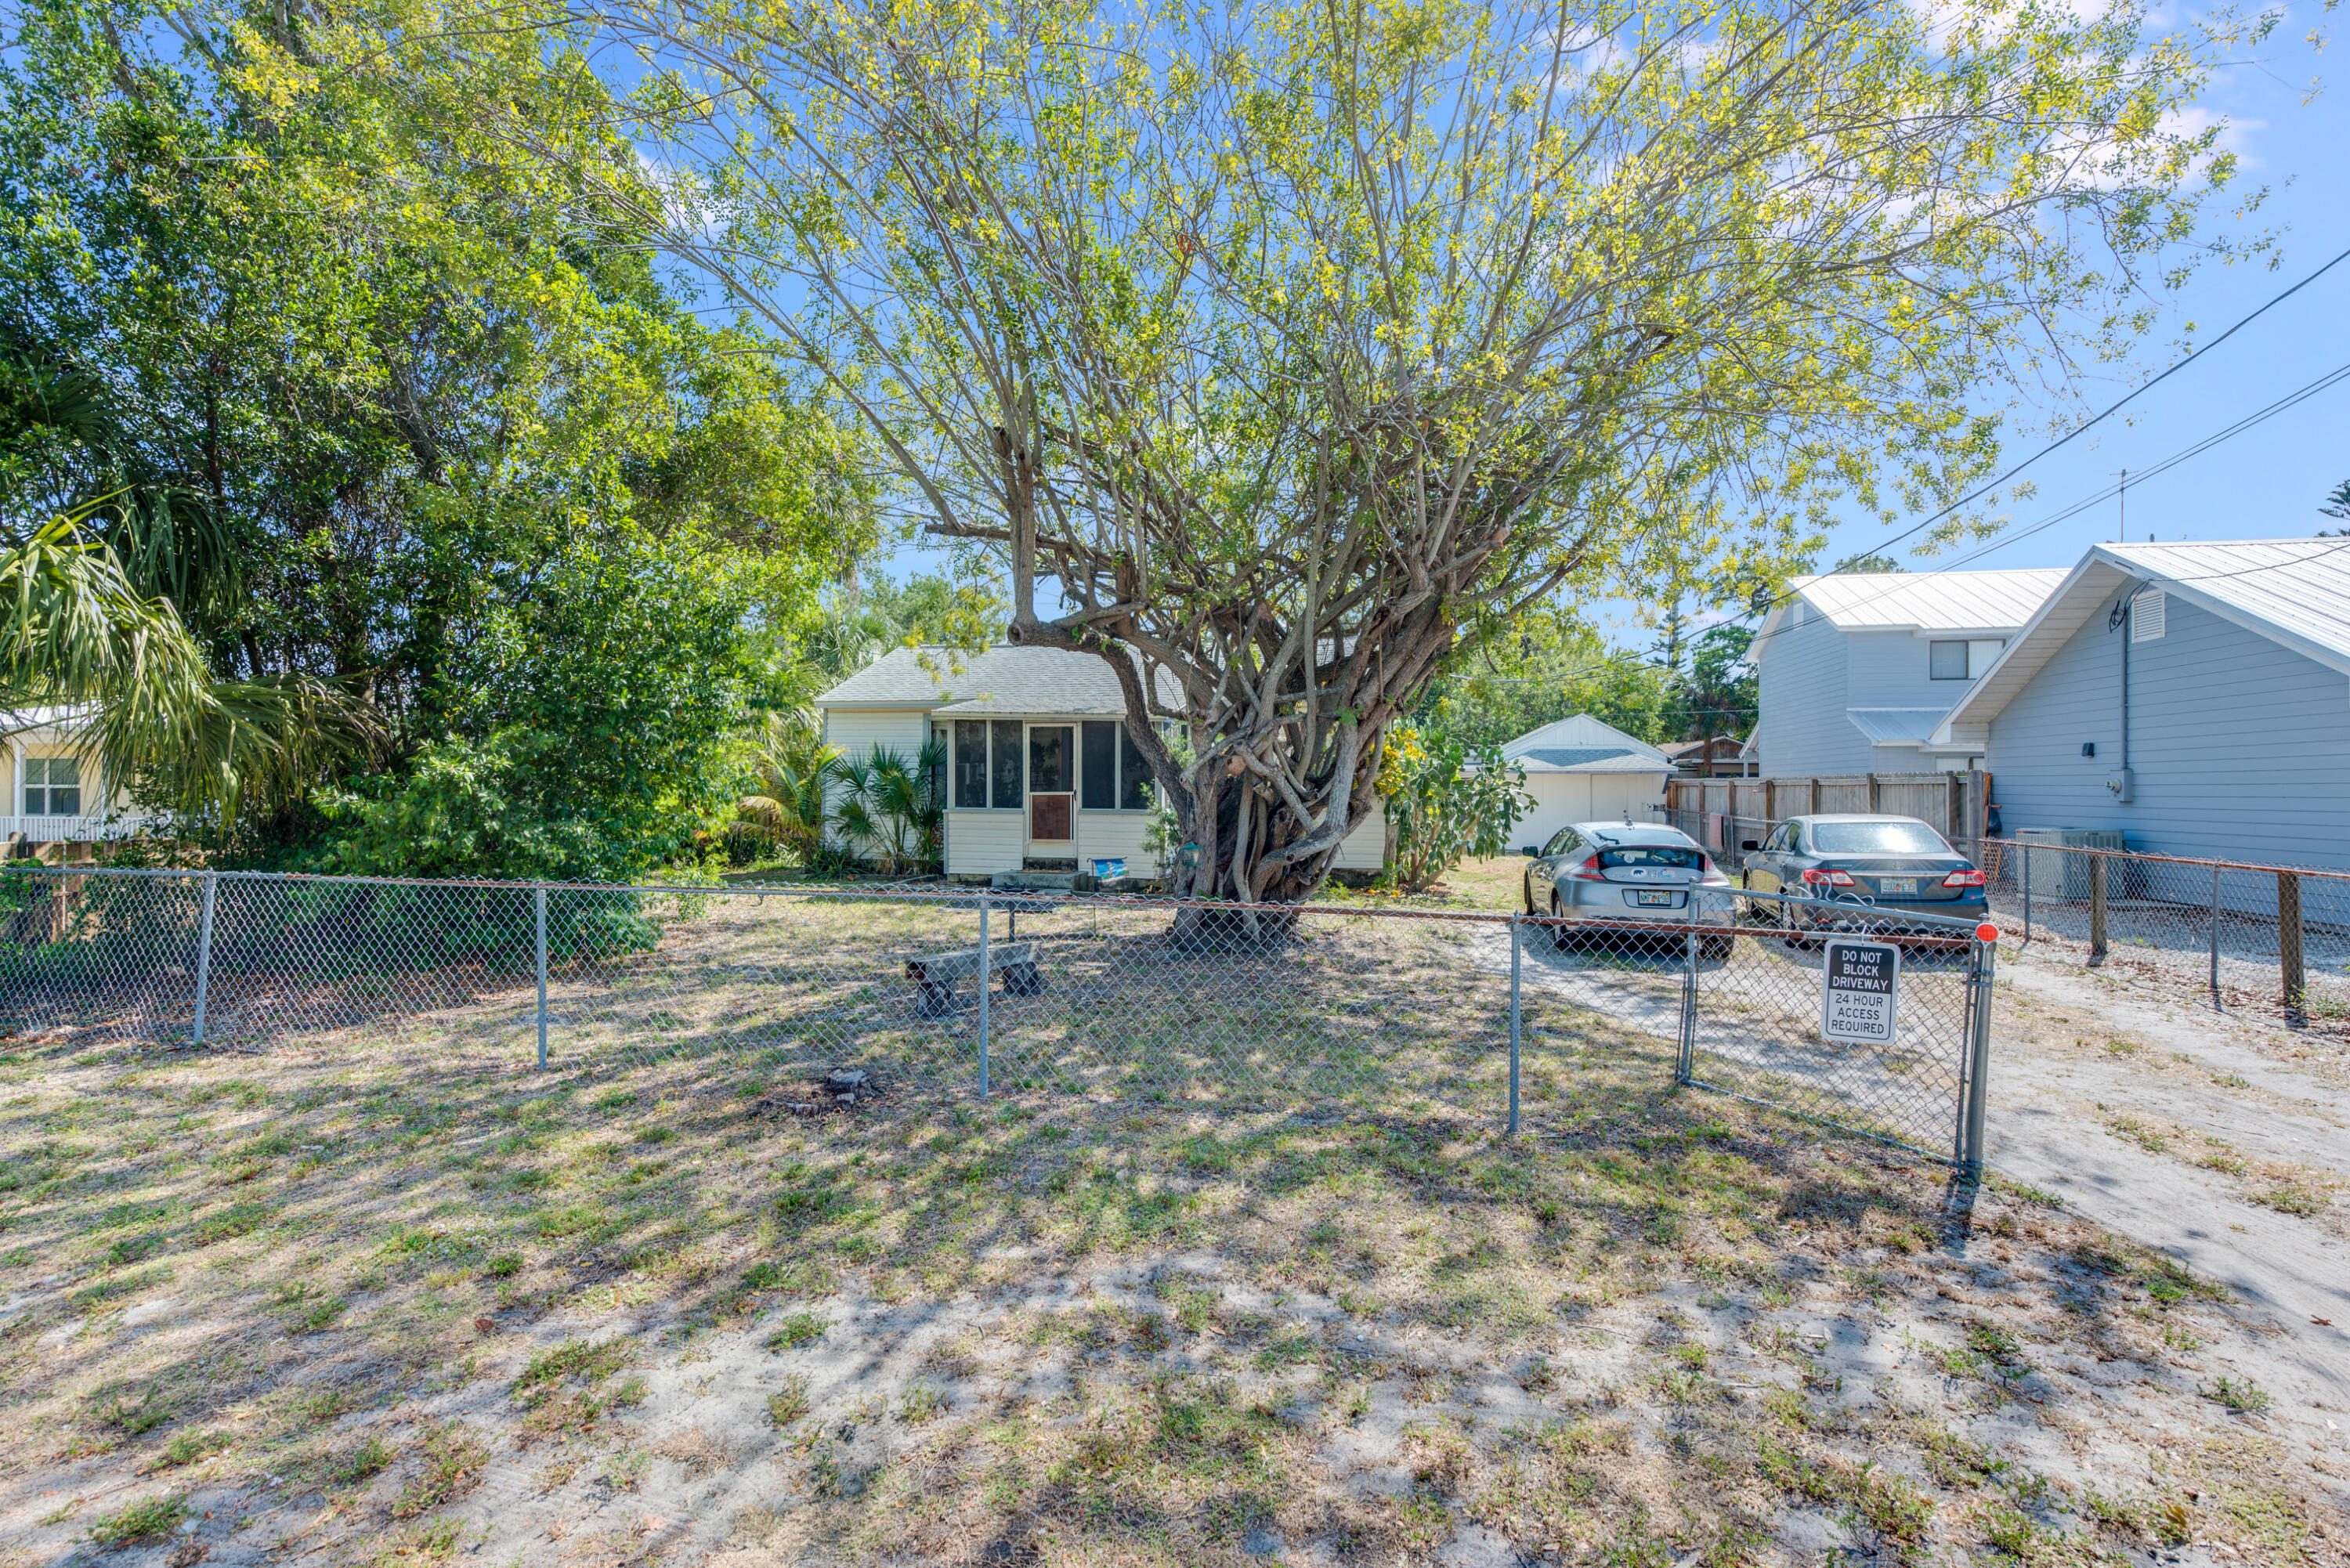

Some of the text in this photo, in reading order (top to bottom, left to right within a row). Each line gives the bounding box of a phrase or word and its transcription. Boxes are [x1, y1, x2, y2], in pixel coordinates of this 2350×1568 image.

[1842, 950, 1882, 963] DO NOT
[1843, 963, 1878, 977] BLOCK
[1833, 976, 1889, 991] DRIVEWAY
[1835, 993, 1883, 1007] 24 HOUR
[1837, 1007, 1880, 1021] ACCESS
[1831, 1020, 1885, 1034] REQUIRED
